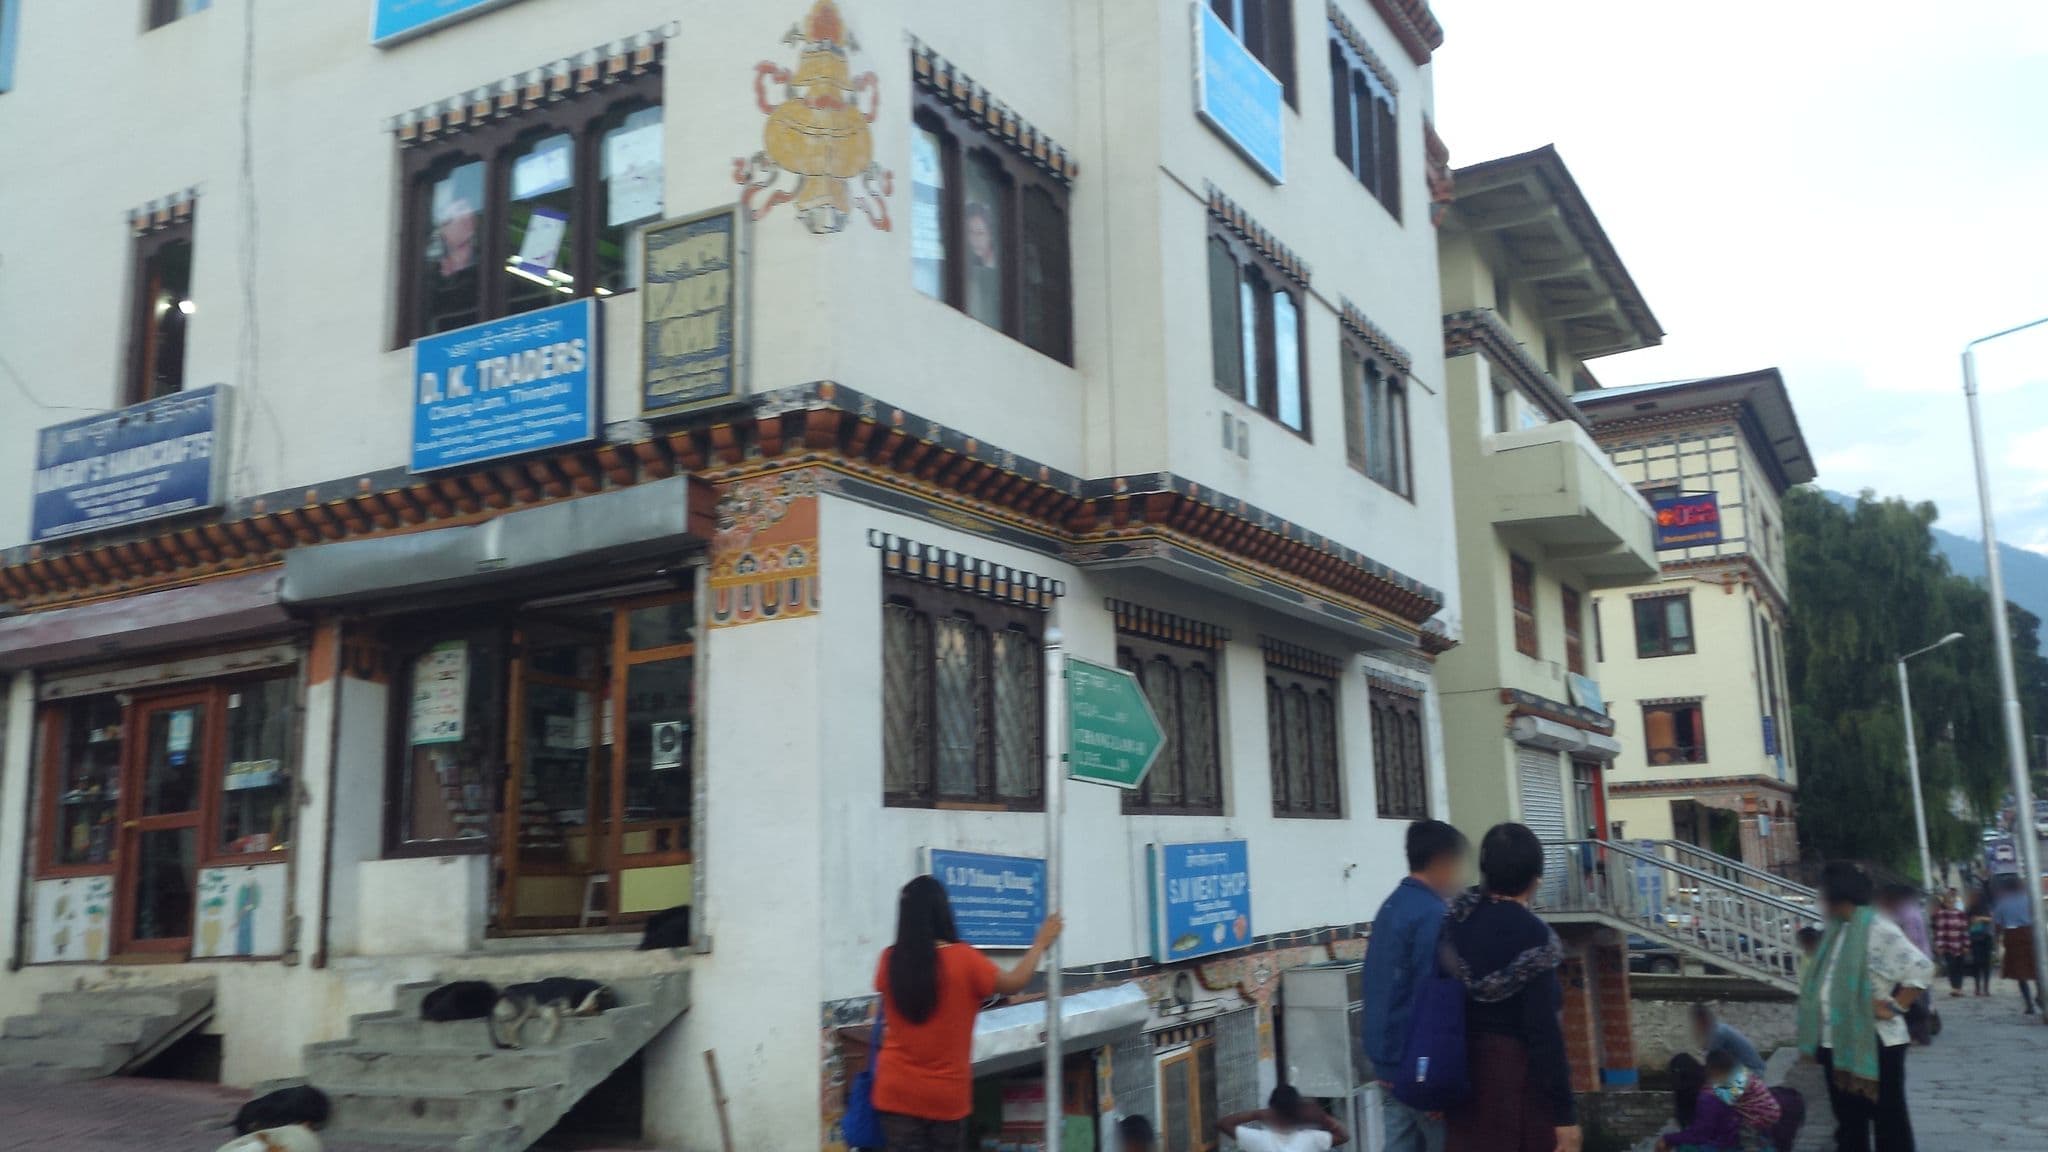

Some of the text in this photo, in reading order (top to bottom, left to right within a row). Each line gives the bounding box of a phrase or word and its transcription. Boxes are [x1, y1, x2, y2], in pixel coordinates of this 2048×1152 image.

[419, 372, 444, 405] D.
[447, 365, 472, 399] K.
[476, 338, 586, 391] TRADERS
[1191, 875, 1219, 901] MEAT
[1219, 872, 1248, 898] SHOP
